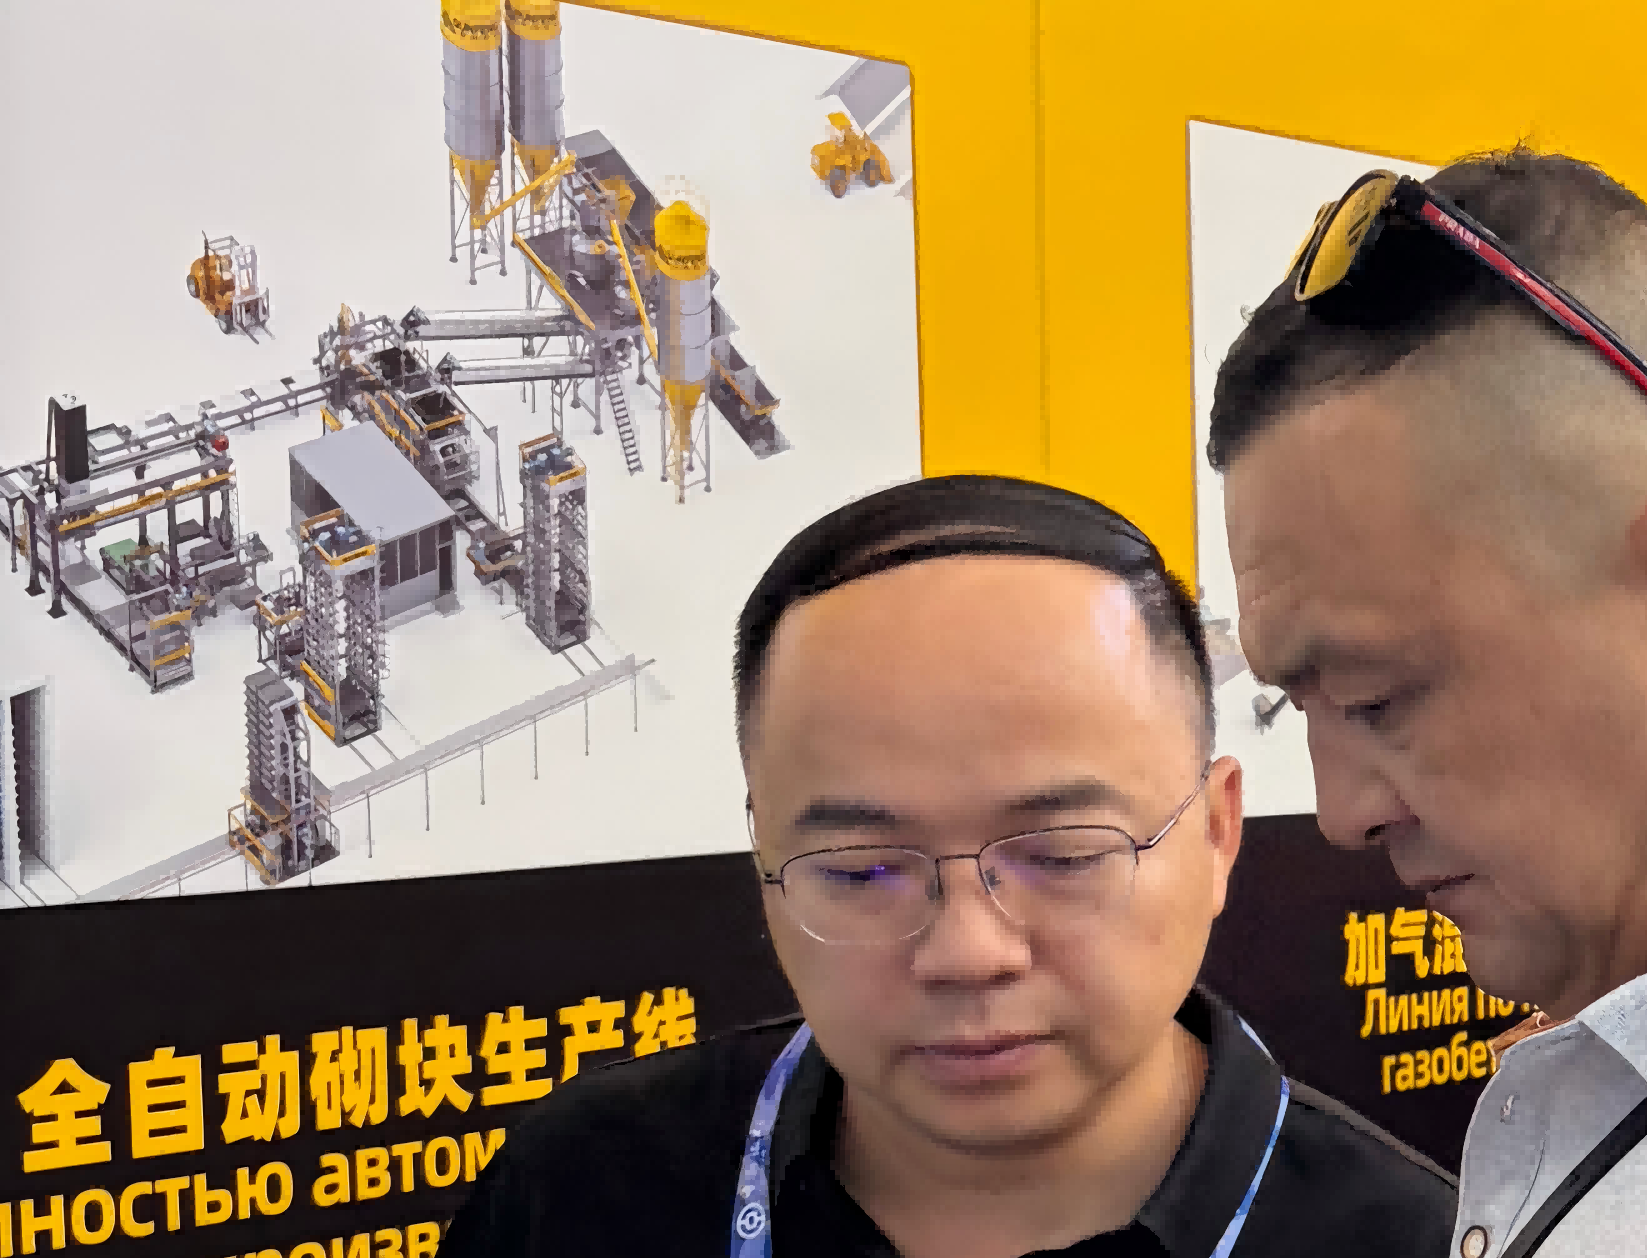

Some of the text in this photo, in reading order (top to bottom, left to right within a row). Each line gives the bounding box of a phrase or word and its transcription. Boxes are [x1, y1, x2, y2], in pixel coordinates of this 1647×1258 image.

[1360, 986, 1469, 1039] Линия
[17, 985, 698, 1174] 全自动砌块生产线
